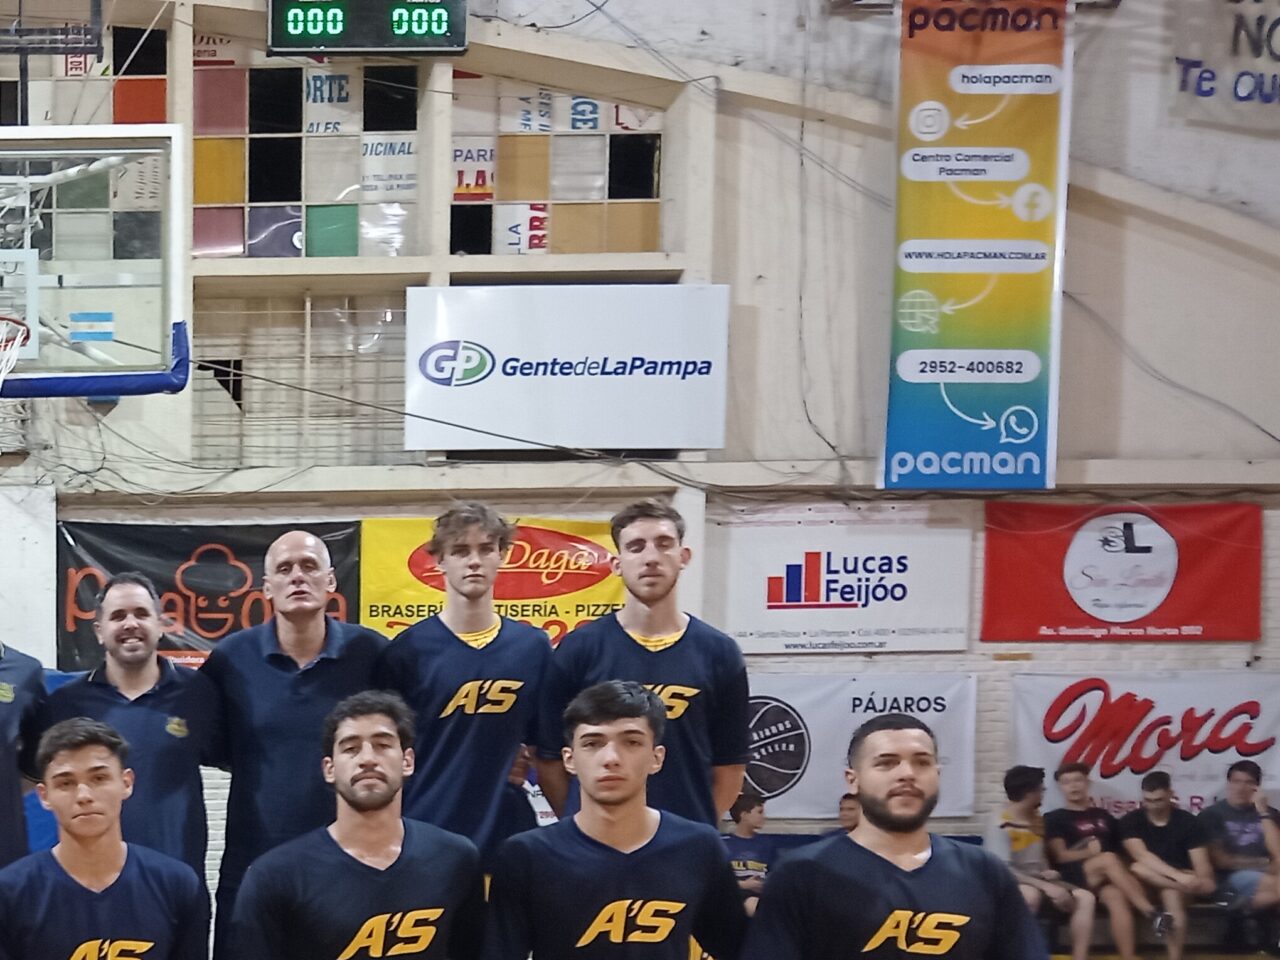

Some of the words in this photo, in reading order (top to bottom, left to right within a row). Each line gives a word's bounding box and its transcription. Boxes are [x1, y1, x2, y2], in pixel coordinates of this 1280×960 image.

[287, 8, 344, 35] 000
[392, 8, 448, 35] 000
[908, 7, 1060, 38] pacman
[960, 72, 1053, 87] holapacman
[918, 360, 1024, 375] 2952-400682
[891, 451, 1040, 482] pacman
[825, 551, 909, 575] Lucas
[825, 576, 908, 608] Feijóo
[369, 601, 445, 618] BRASERÍ
[438, 679, 525, 719] A'S
[851, 691, 948, 714] PÁJAROS
[1042, 677, 1277, 779] Mora
[575, 898, 688, 948] A'S
[860, 908, 971, 956] A'S
